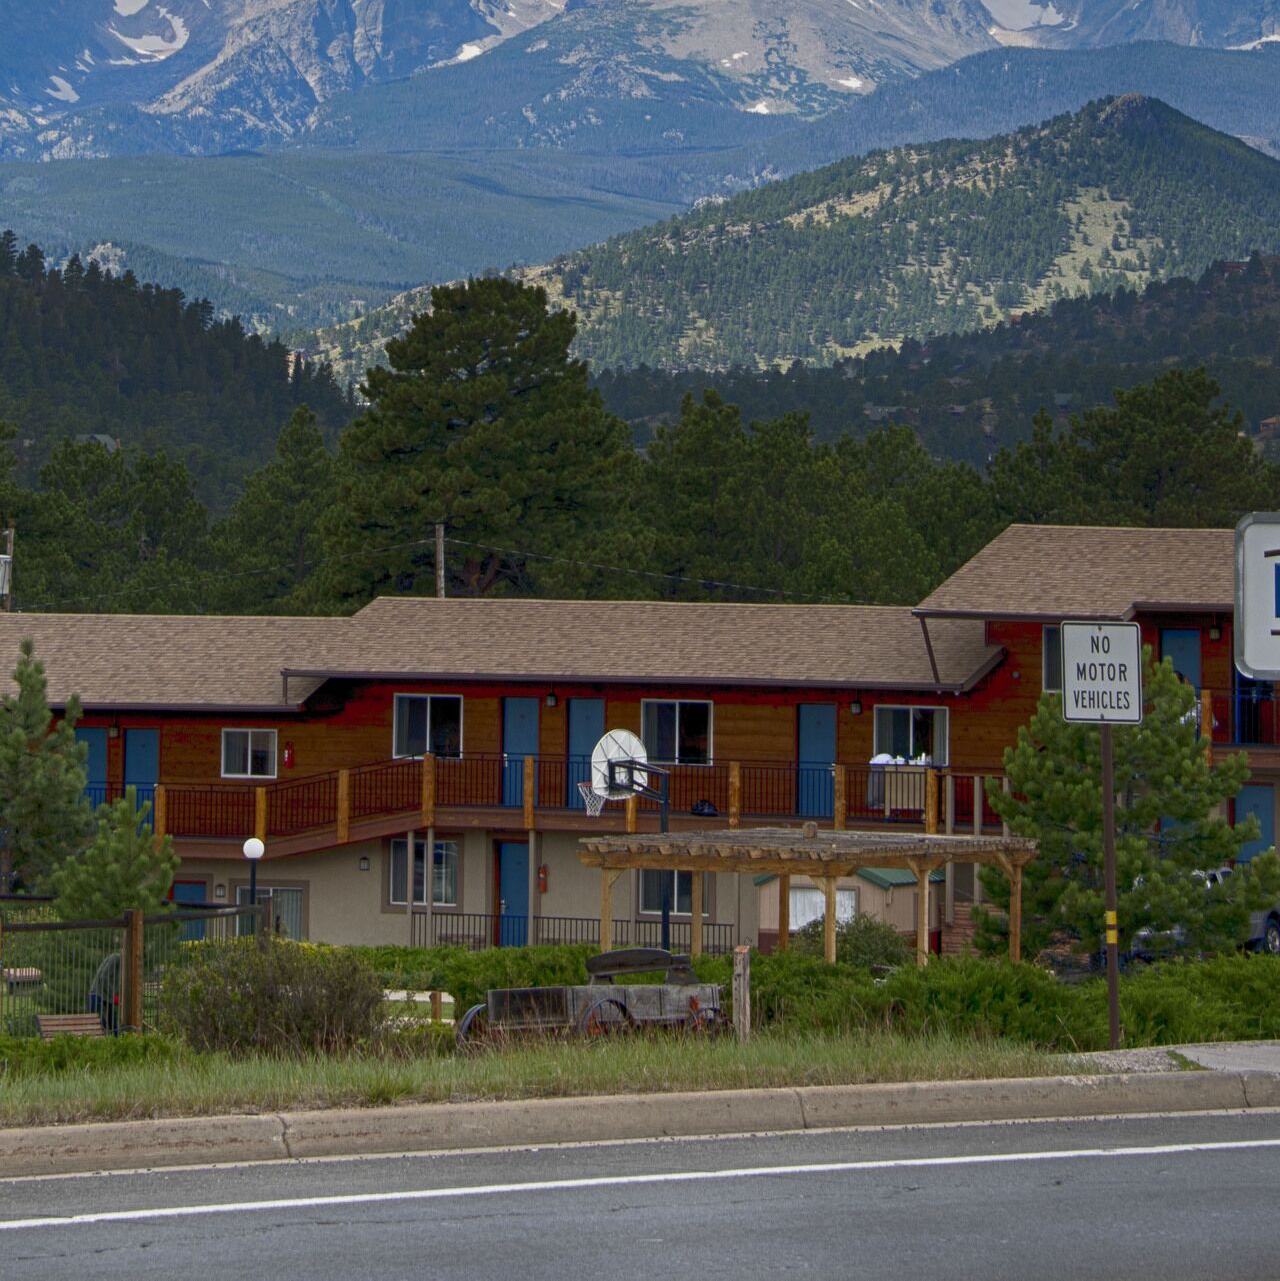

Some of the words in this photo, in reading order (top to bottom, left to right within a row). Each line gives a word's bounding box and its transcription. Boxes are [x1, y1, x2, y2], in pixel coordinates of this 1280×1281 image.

[1091, 635, 1110, 654] NO
[1076, 662, 1127, 682] MOTOR
[1073, 690, 1130, 710] VEHICLES
